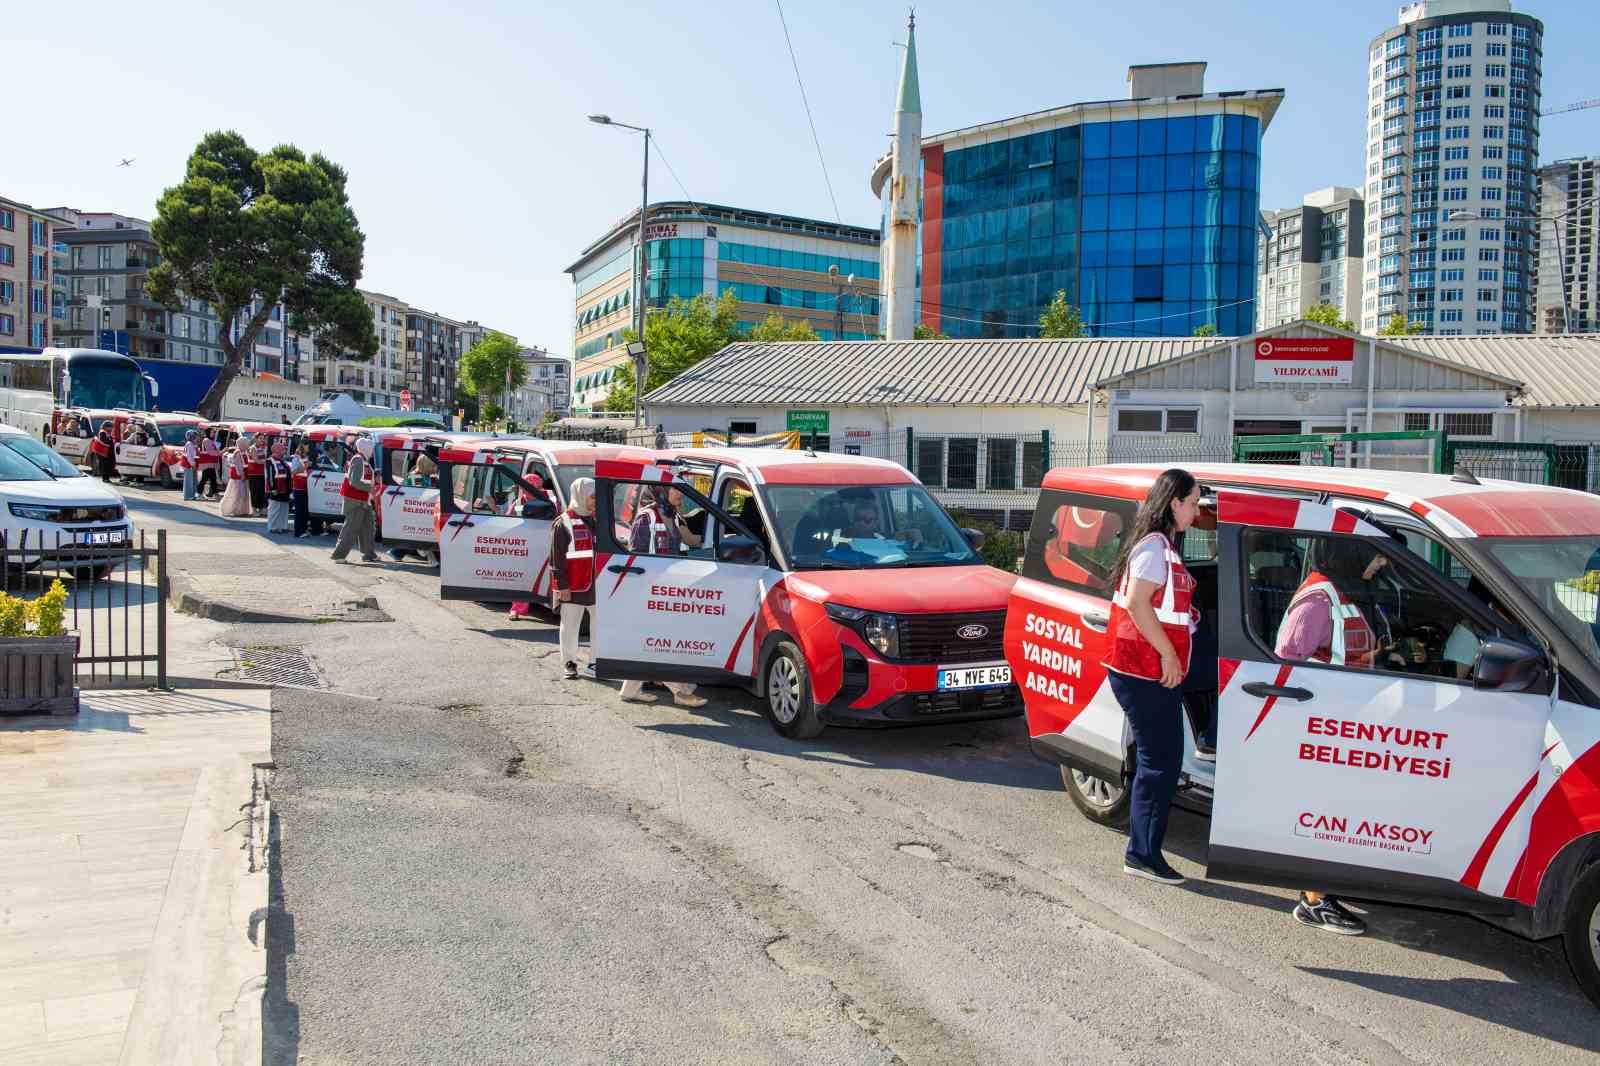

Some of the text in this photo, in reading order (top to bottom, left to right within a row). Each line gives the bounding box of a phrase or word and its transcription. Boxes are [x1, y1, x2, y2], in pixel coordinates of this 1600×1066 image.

[476, 536, 527, 546] ESENYURT
[475, 569, 524, 578] CAN AKSOY
[651, 585, 723, 601] ESENYURT
[647, 600, 726, 616] BELEDİYESİ
[1024, 613, 1083, 650] SOSYAL
[646, 637, 715, 651] CAN AKSOY
[1022, 640, 1082, 679] YARDIM
[946, 668, 1009, 686] 34 MVE 645
[1025, 671, 1074, 705] ARACI
[1307, 716, 1448, 750] ESENYURT
[1299, 743, 1451, 779] BELEDİYESİ
[1299, 812, 1433, 845] CAN AKSOY
[1314, 832, 1346, 843] ESENYURT
